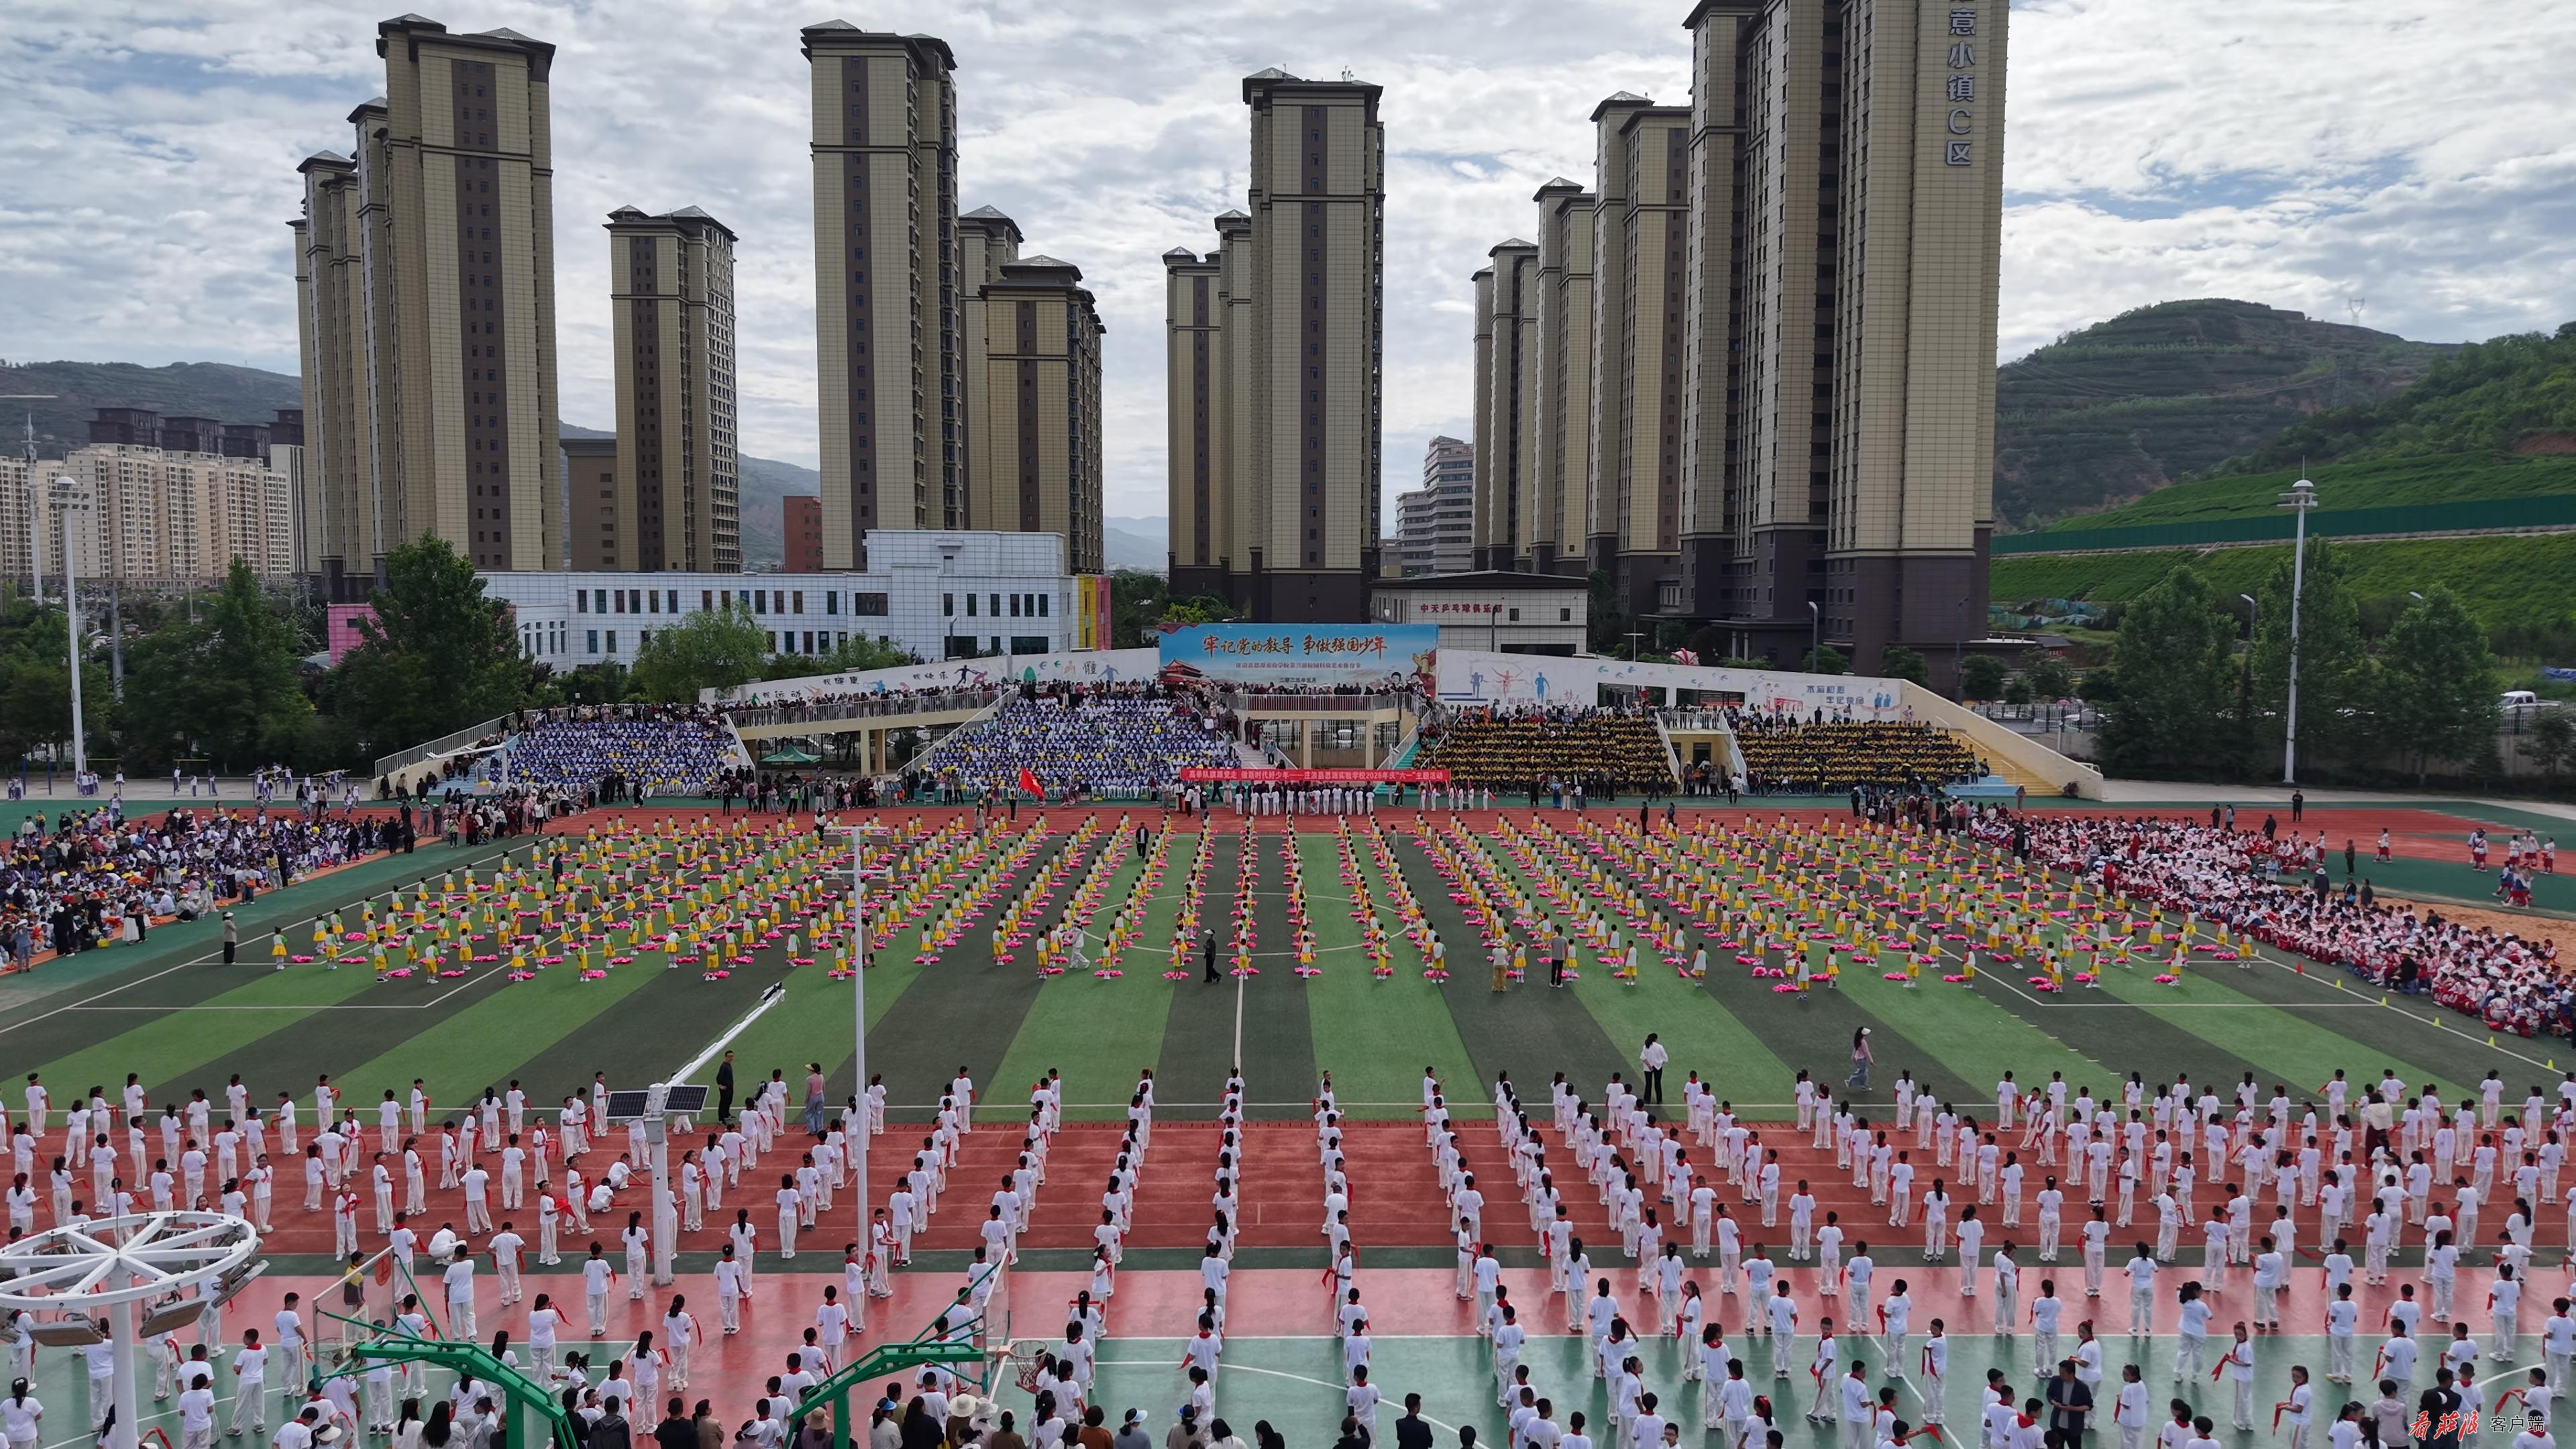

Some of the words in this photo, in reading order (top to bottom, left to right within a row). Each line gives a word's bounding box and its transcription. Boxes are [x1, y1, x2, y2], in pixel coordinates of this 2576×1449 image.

[1945, 0, 1976, 166] 意小镇C区
[1420, 603, 1503, 613] 中天乒乓球俱乐部
[1203, 634, 1294, 659] 牢记党的教导
[1303, 634, 1387, 660] 争做强国少年
[1189, 770, 1237, 779] 高举队旗跟党走
